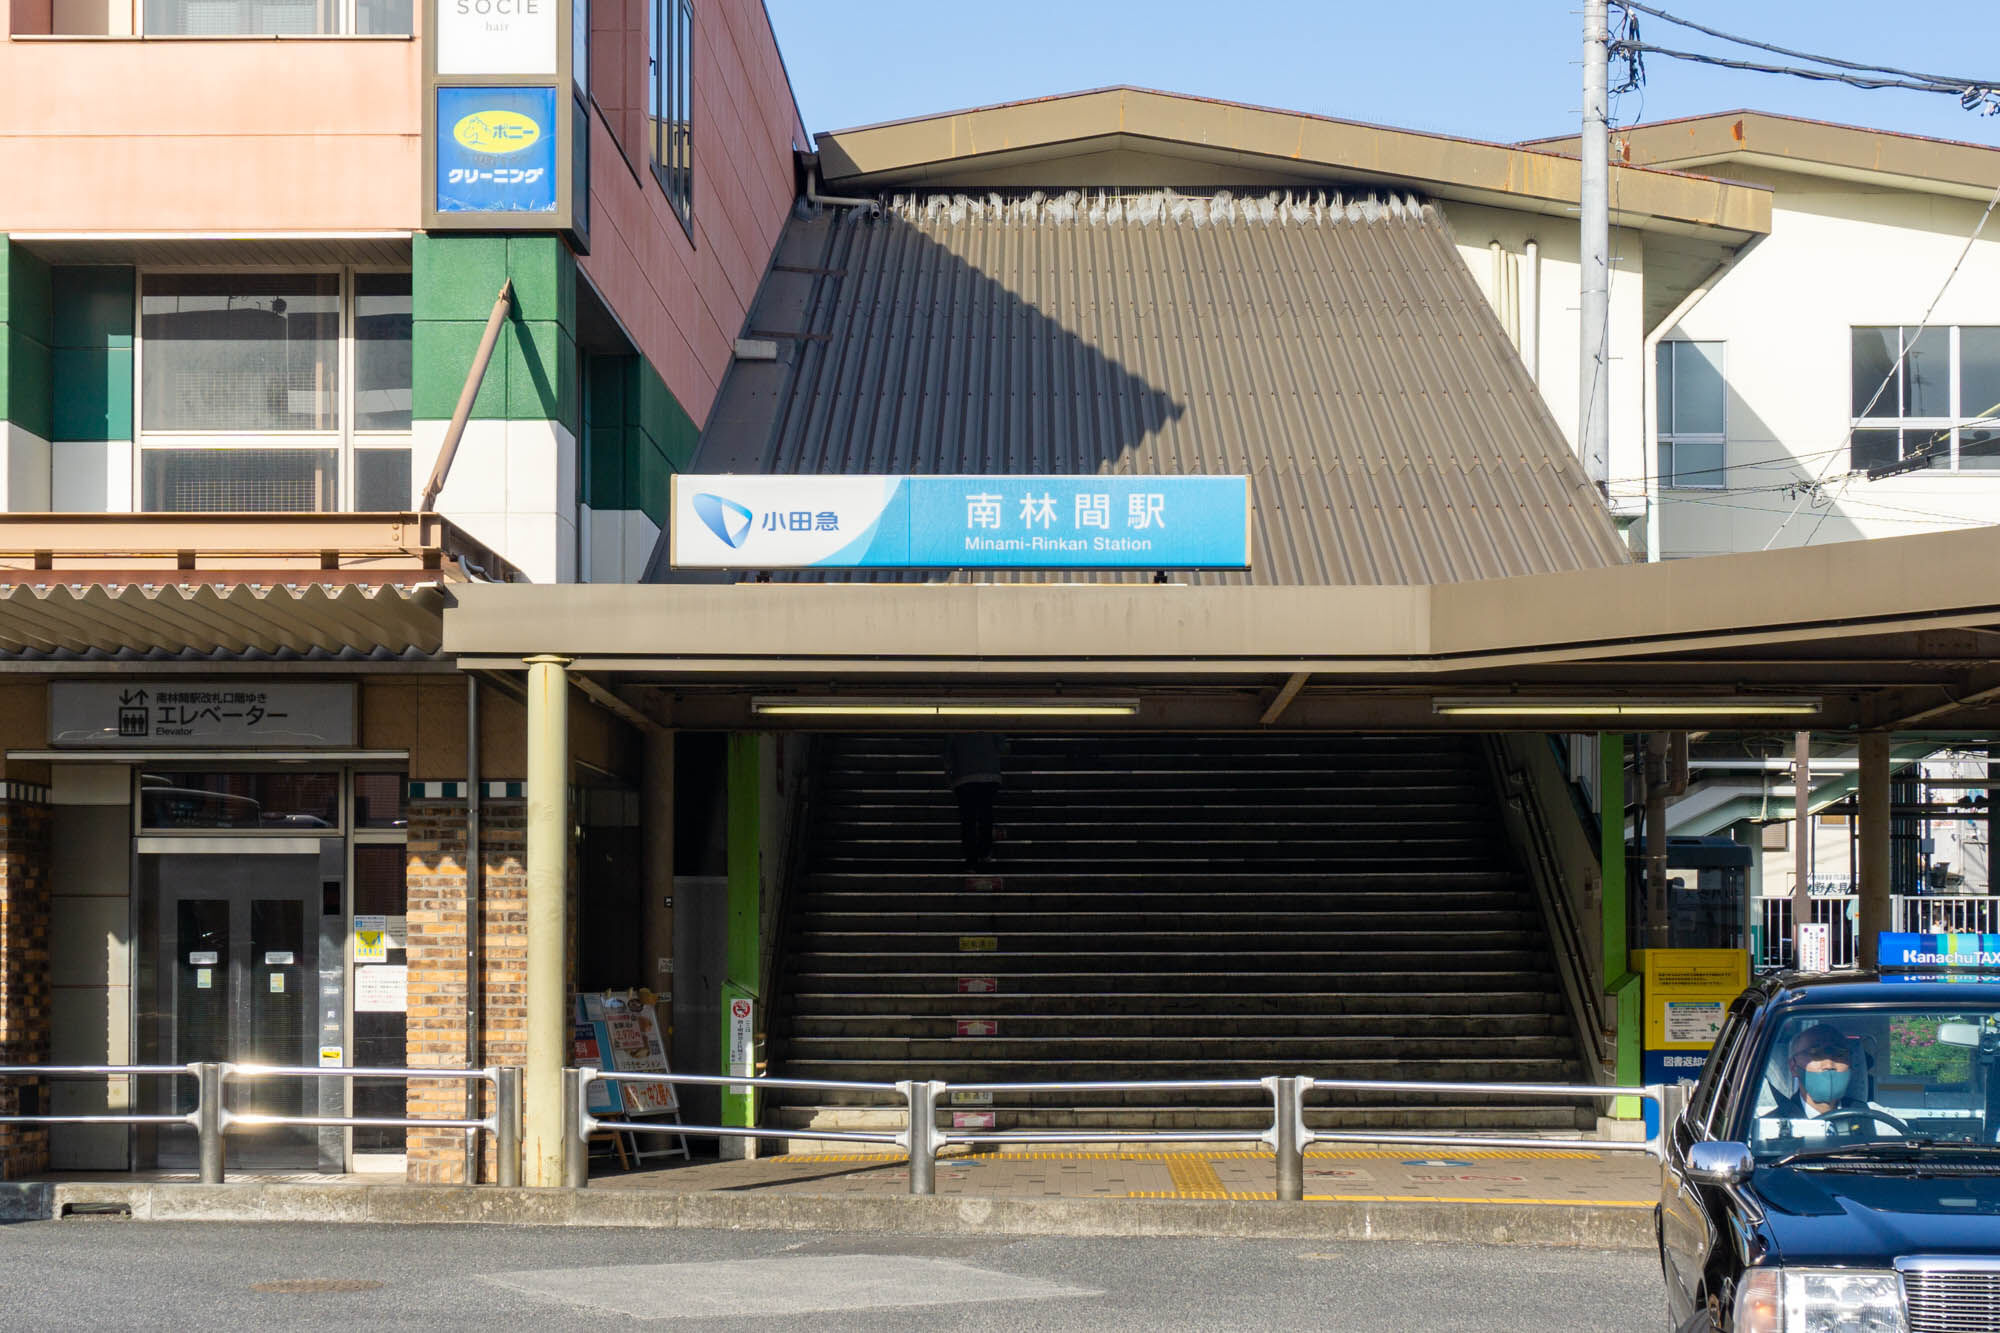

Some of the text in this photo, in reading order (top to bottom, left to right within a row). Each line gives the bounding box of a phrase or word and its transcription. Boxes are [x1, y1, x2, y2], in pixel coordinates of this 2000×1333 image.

[456, 0, 539, 15] SOCIE
[485, 21, 510, 32] hair
[448, 168, 544, 184] クリーニング
[965, 492, 1165, 530] 南林間駅
[762, 511, 840, 532] 小田急
[965, 536, 1152, 551] Minami-Rinkan Station
[156, 705, 289, 726] エレベーター
[155, 727, 193, 736] Elevator
